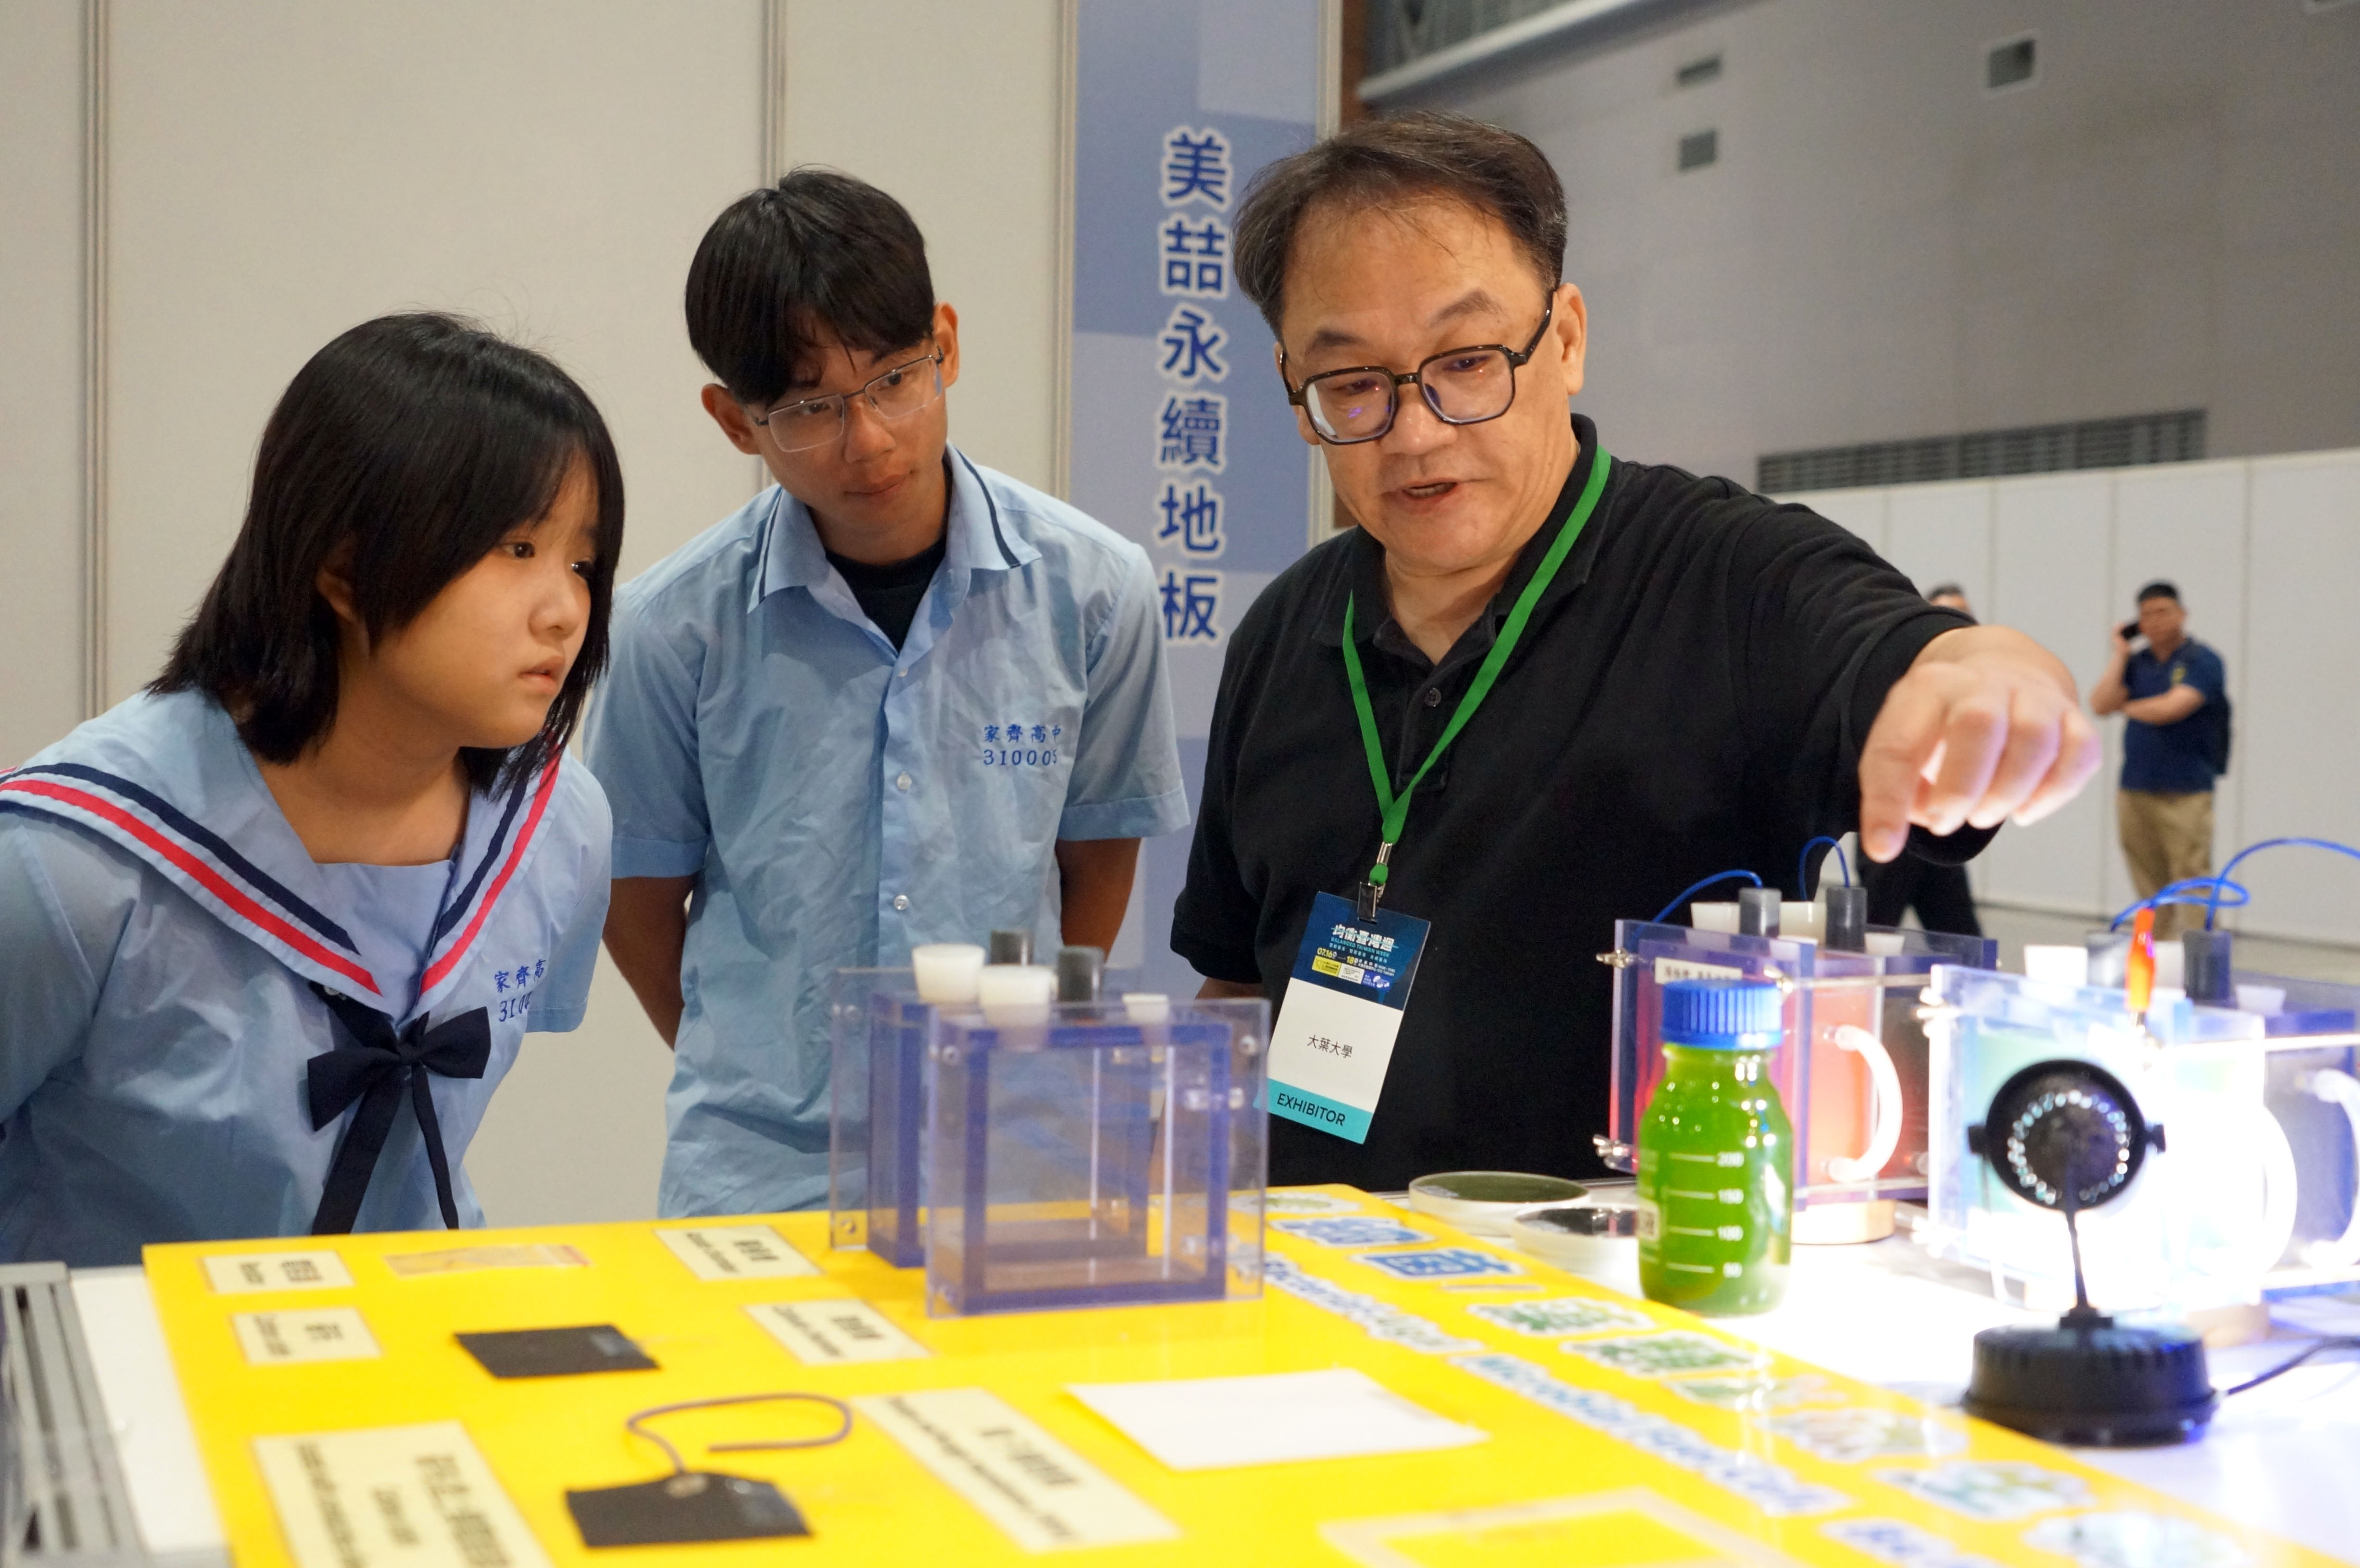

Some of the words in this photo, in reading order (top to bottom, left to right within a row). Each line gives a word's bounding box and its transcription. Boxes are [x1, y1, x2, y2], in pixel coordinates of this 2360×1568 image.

[1159, 133, 1226, 638] 美喆永續地板
[984, 724, 1061, 744] 家齊高中
[1306, 1034, 1353, 1058] 大葉大學
[1277, 1093, 1346, 1126] EXHIBITOR
